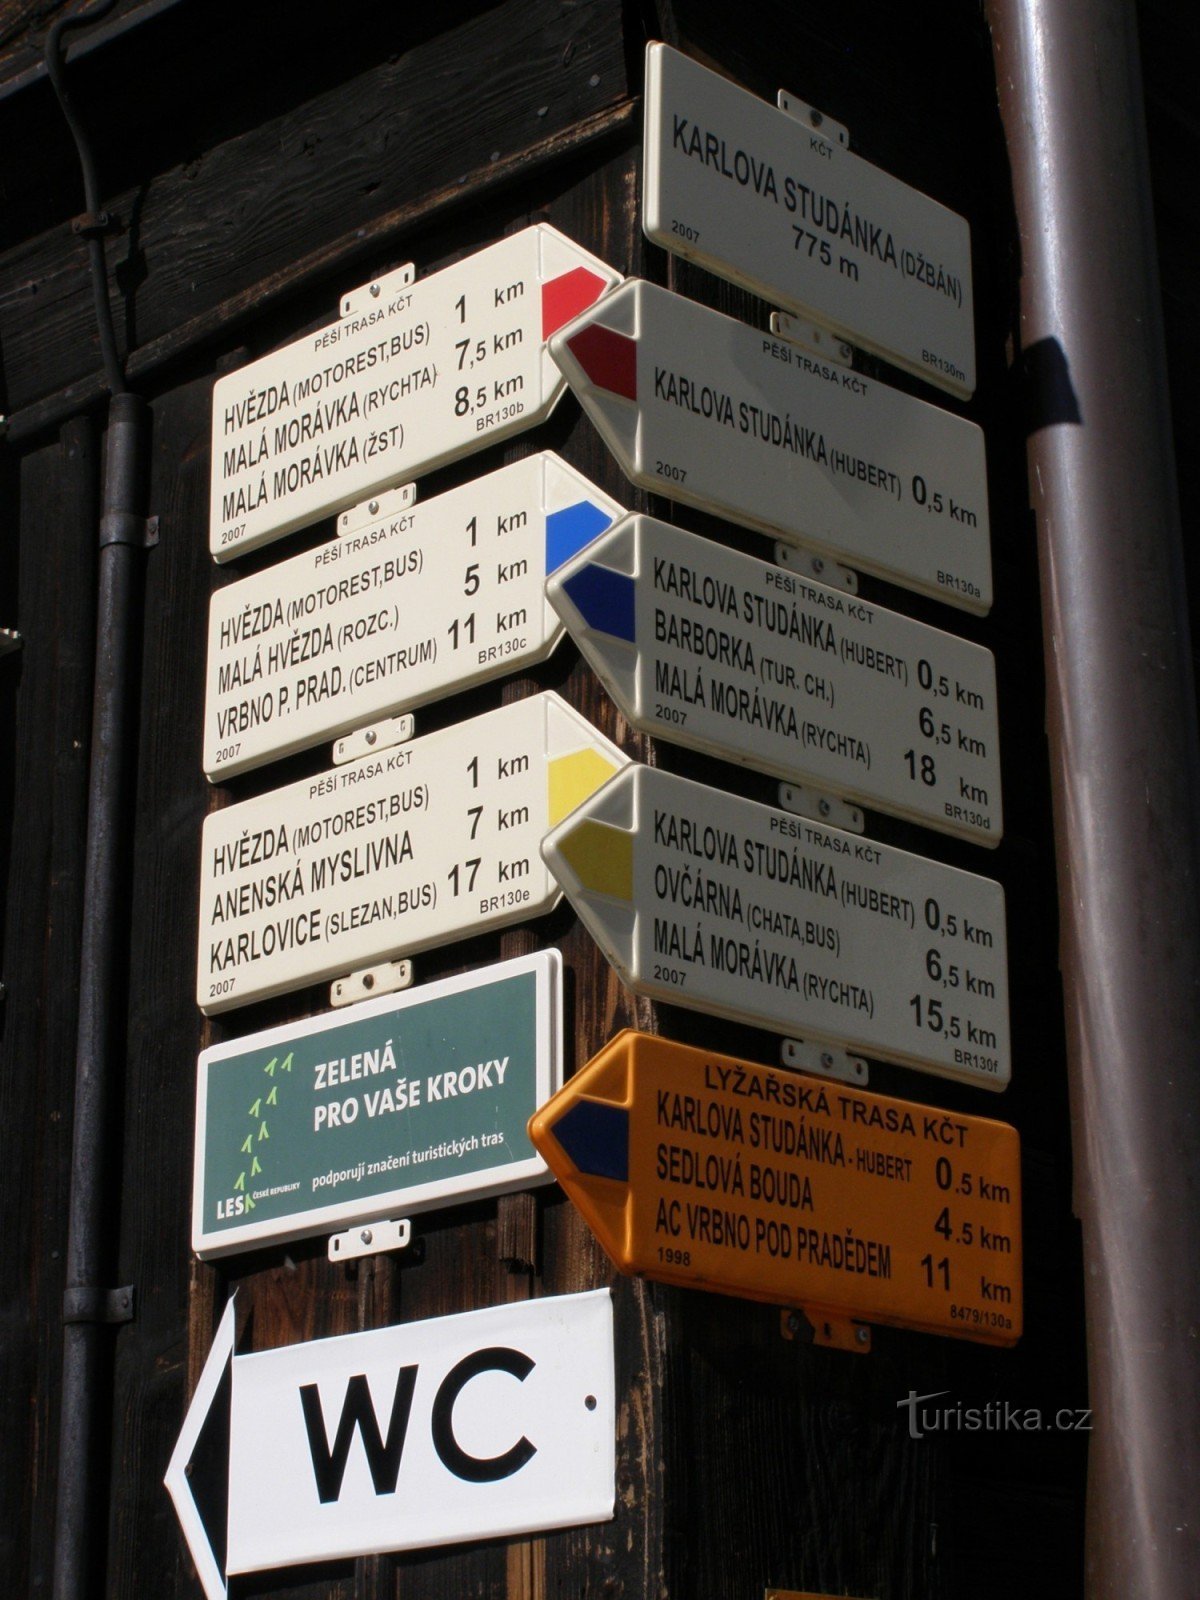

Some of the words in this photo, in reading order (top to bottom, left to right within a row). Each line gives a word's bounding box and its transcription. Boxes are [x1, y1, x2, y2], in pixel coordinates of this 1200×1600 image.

[810, 137, 833, 160] KČT
[673, 114, 778, 205] KARLOVA
[784, 176, 898, 269] STUDÁNKA
[672, 220, 699, 243] 2007
[792, 225, 832, 266] 775
[840, 257, 859, 282] m
[314, 326, 341, 352] PĚŠÍ
[343, 309, 385, 337] TRASA
[388, 295, 412, 316] KČT
[225, 380, 290, 435] HVĚZDA
[455, 295, 466, 323] 1
[495, 280, 524, 308] km
[763, 340, 791, 363] PĚŠÍ
[796, 356, 838, 384] TRASA
[842, 377, 867, 396] KČT
[922, 350, 966, 382] BR130m
[223, 427, 269, 479] MALÁ
[274, 390, 360, 455] MORÁVKA
[493, 328, 523, 355] km
[476, 402, 524, 431] BR130b
[222, 471, 268, 524] MALÁ
[273, 435, 359, 499] MORÁVKA
[493, 374, 524, 401] km
[655, 367, 735, 429] KARLOVA
[739, 401, 827, 466] STUDÁNKA
[950, 498, 977, 527] km
[656, 462, 687, 482] 2007
[221, 524, 246, 544] 2007
[314, 542, 342, 568] PĚŠÍ
[345, 526, 386, 555] TRASA
[390, 516, 415, 537] KČT
[221, 599, 284, 650] HVĚZDA
[466, 517, 477, 546] 1
[497, 510, 527, 536] km
[766, 571, 797, 595] PĚŠÍ
[800, 584, 844, 614] TRASA
[849, 604, 874, 624] KČT
[937, 569, 981, 598] BR130a
[219, 644, 263, 694] MALÁ
[268, 623, 333, 675] HVĚZDA
[464, 564, 479, 596] 5
[497, 559, 527, 584] km
[478, 637, 527, 664] BR130c
[654, 556, 738, 619] KARLOVA
[743, 591, 837, 656] STUDÁNKA
[956, 681, 984, 711] km
[217, 687, 274, 740] VRBNO
[279, 686, 290, 717] P.
[296, 665, 346, 710] PRAD.
[448, 613, 476, 650] 11
[497, 607, 527, 633] km
[655, 608, 755, 675] BARBORKA
[958, 728, 986, 758] km
[656, 704, 687, 726] 2007
[656, 659, 705, 706] MALÁ
[711, 677, 798, 739] MORÁVKA
[904, 749, 936, 787] 18
[960, 776, 988, 806] km
[216, 744, 241, 763] 2007
[310, 774, 337, 799] PĚŠÍ
[340, 759, 383, 789] TRASA
[386, 750, 413, 772] KČT
[213, 824, 288, 878] HVĚZDA
[467, 757, 479, 788] 1
[498, 755, 529, 780] km
[770, 817, 801, 839] PĚŠÍ
[805, 829, 850, 855] TRASA
[854, 844, 881, 865] KČT
[945, 802, 990, 830] BR130d
[211, 860, 304, 925] ANENSKÁ
[311, 830, 414, 893] MYSLIVNA
[467, 806, 483, 840] 7
[498, 806, 529, 831] km
[654, 809, 739, 869] KARLOVA
[744, 839, 837, 901] STUDÁNKA
[964, 919, 993, 948] km
[210, 909, 321, 973] KARLOVICE
[447, 859, 482, 897] 17
[498, 858, 529, 884] km
[479, 890, 530, 914] BR130e
[655, 863, 742, 924] OVČÁRNA
[966, 968, 995, 999] km
[209, 979, 236, 997] 2007
[654, 965, 686, 986] 2007
[654, 918, 705, 965] MALÁ
[711, 934, 799, 992] MORÁVKA
[968, 1019, 996, 1049] km
[314, 1039, 396, 1090] ZELENÁ
[954, 1049, 998, 1073] BR130f
[314, 1097, 359, 1132] PRO
[363, 1079, 421, 1119] VAŠE
[428, 1057, 510, 1103] KROKY
[705, 1065, 831, 1117] LYŽAŘSKÁ
[838, 1096, 916, 1137] TRASA
[924, 1115, 968, 1148] KČT
[312, 1162, 364, 1191] podporují
[367, 1152, 410, 1176] značení
[412, 1135, 478, 1164] turistických
[481, 1132, 504, 1151] tras
[658, 1090, 744, 1144] KARLOVA
[750, 1111, 845, 1168] STUDÁNKA
[856, 1148, 912, 1182] HUBERT
[979, 1173, 1010, 1204] km
[270, 1182, 301, 1195] REPUBLIKY
[657, 1143, 744, 1197] SEDLOVÁ
[750, 1163, 814, 1212] BOUDA
[980, 1223, 1011, 1254] km
[656, 1198, 681, 1236] AC
[687, 1201, 750, 1250] VRBNO
[755, 1218, 791, 1258] POD
[798, 1227, 891, 1279] PRADĚDEM
[921, 1254, 950, 1291] 11
[981, 1277, 1011, 1304] km
[657, 1247, 690, 1266] 1998
[950, 1305, 1012, 1330] 8479/130a
[298, 1347, 538, 1505] WC
